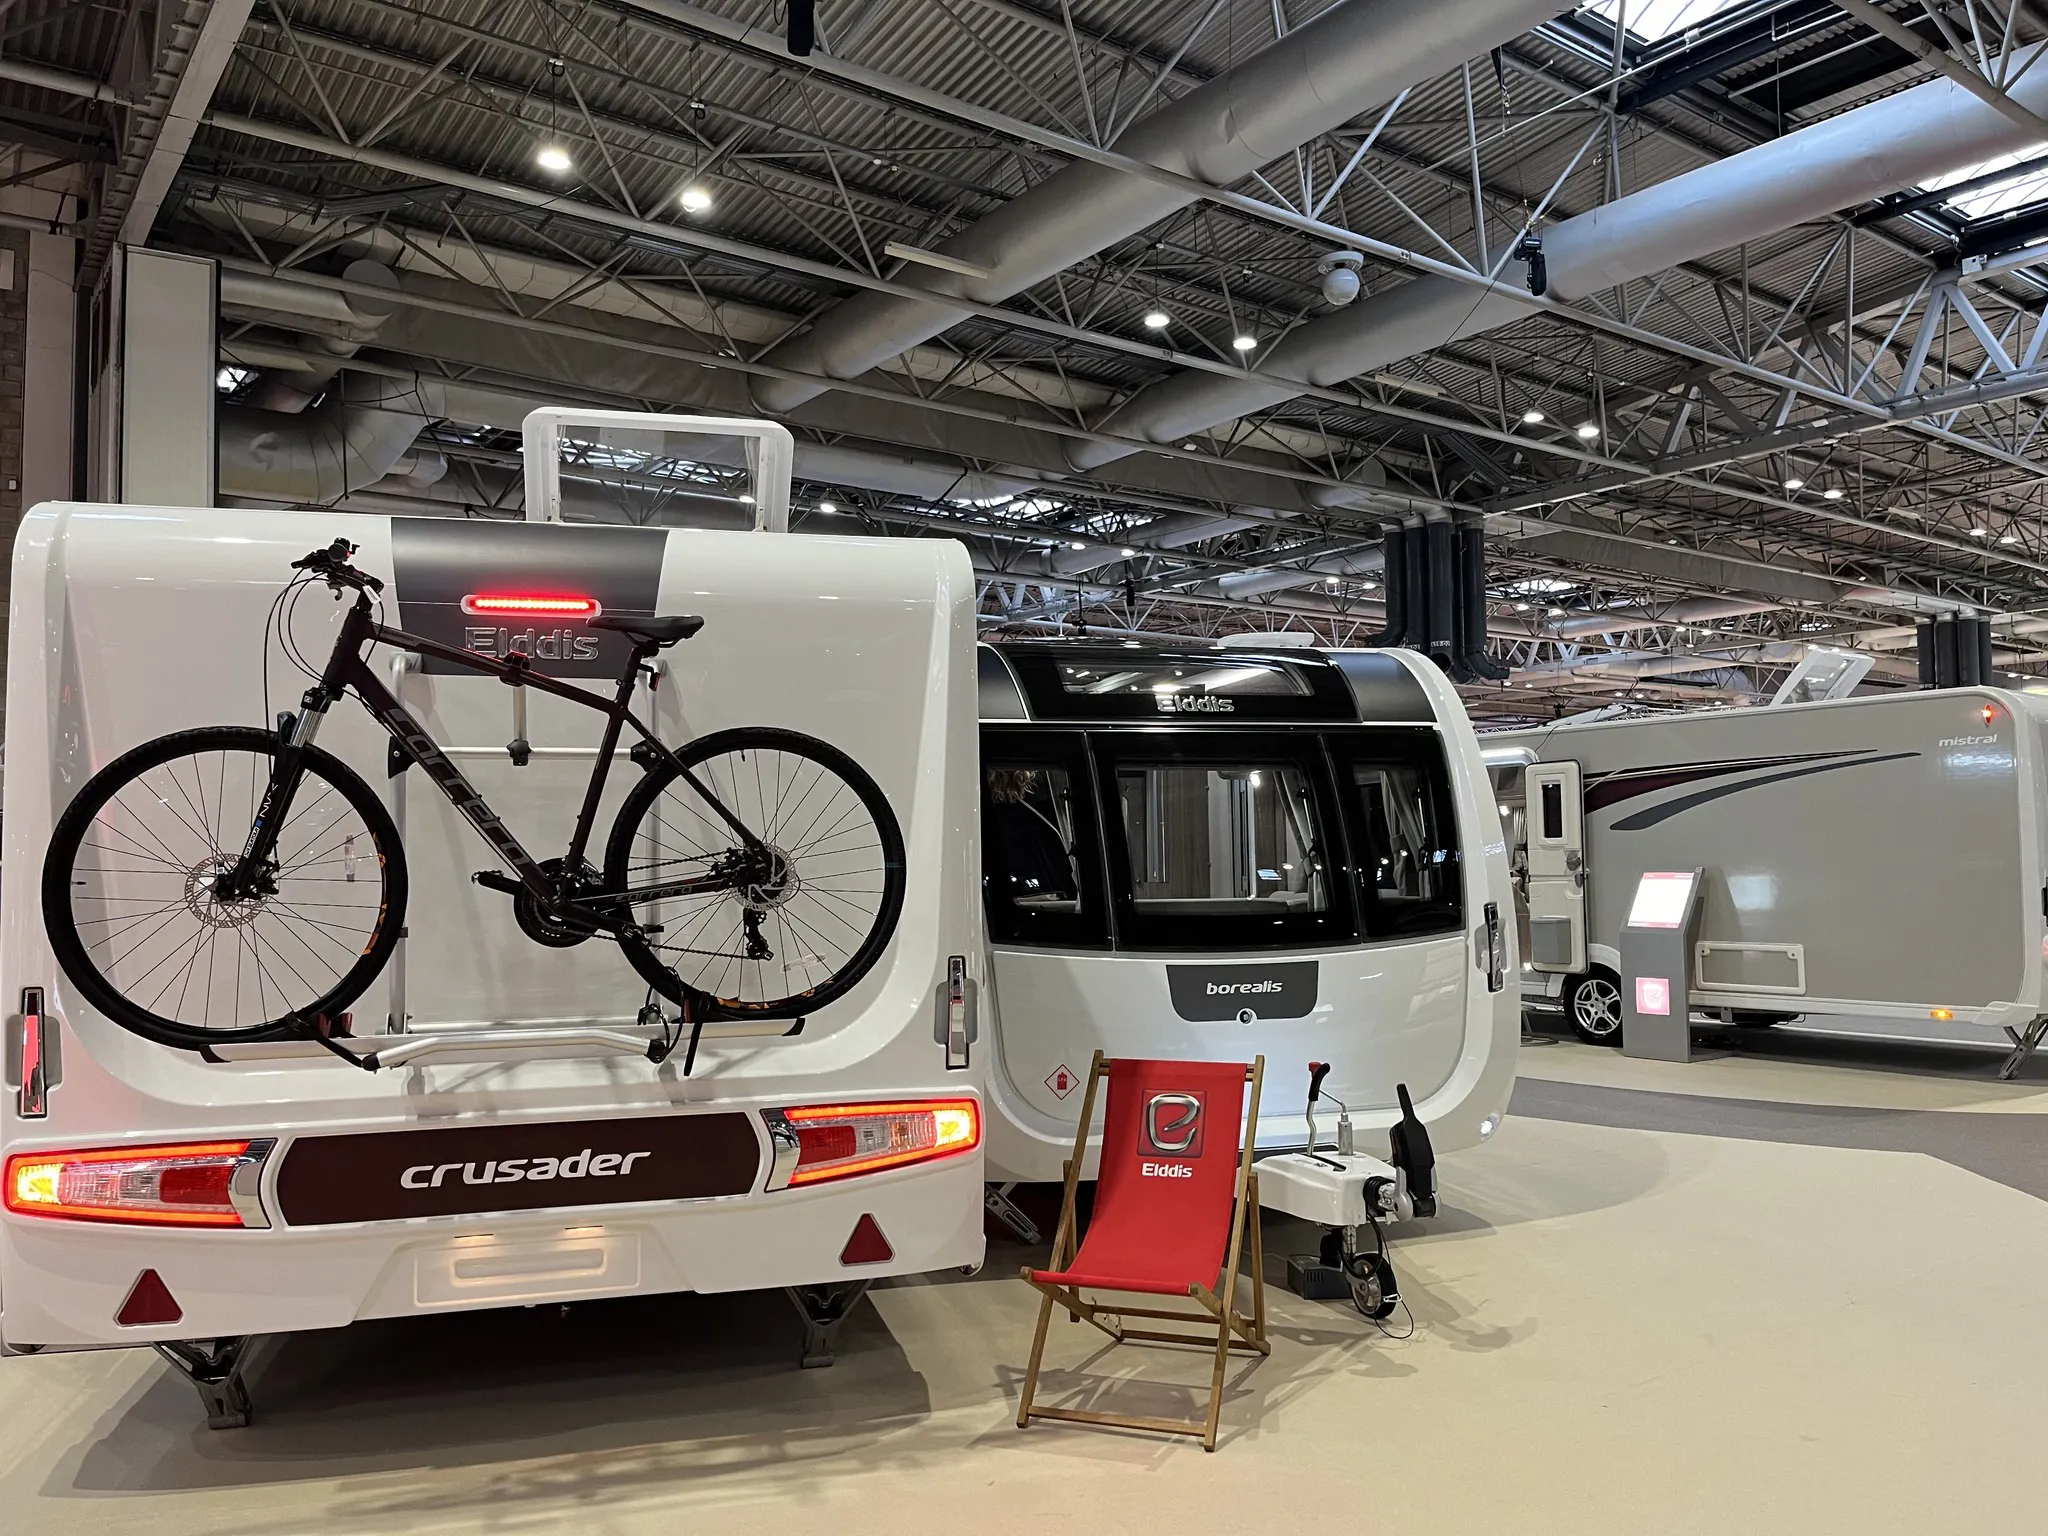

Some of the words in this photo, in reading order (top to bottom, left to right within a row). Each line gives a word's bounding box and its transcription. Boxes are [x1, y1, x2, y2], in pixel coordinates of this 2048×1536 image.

[464, 626, 599, 660] Elddis
[1154, 694, 1235, 712] Elddis
[1938, 733, 1998, 747] mistral
[383, 708, 530, 865] carrera
[615, 885, 693, 902] carrera
[1206, 980, 1283, 995] borealis
[400, 1149, 651, 1188] crusader
[1141, 1162, 1193, 1178] Elddis
